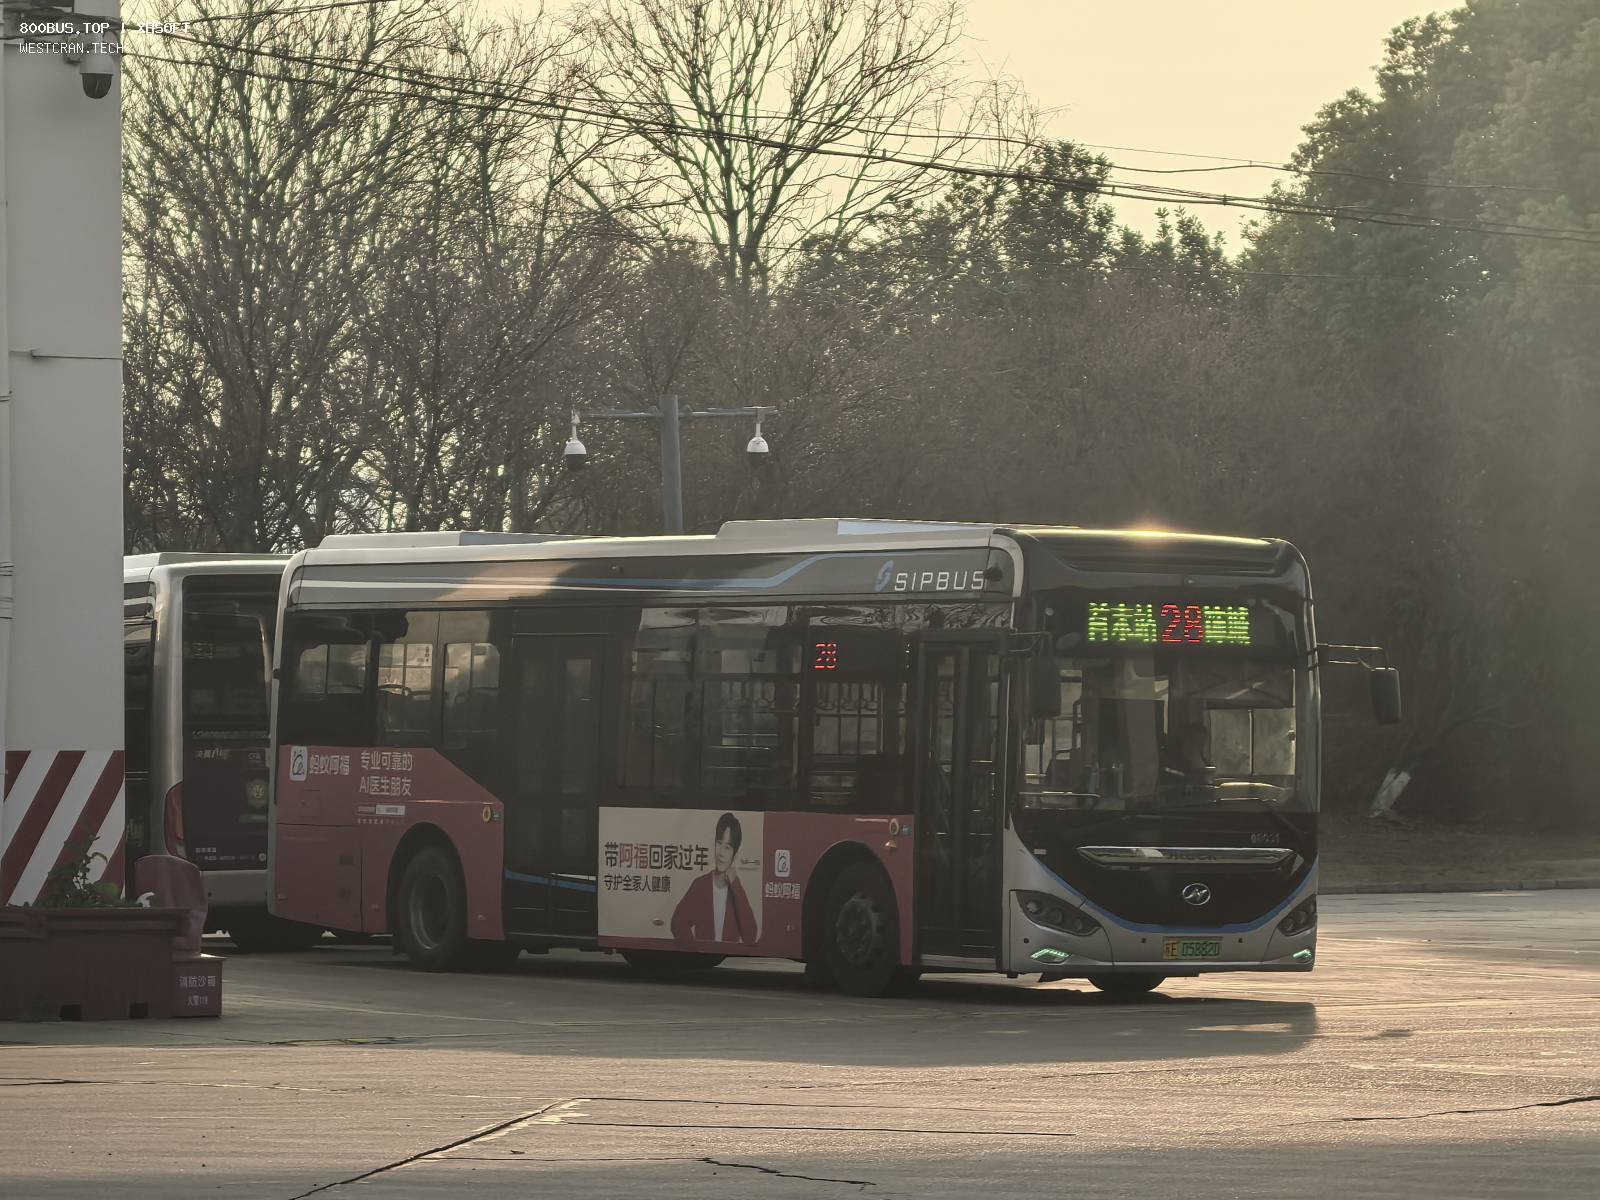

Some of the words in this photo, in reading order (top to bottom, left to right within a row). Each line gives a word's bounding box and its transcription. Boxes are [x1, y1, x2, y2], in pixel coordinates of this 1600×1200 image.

[894, 570, 985, 592] SIPBUS
[1161, 604, 1203, 643] 28
[814, 643, 838, 669] 28
[360, 751, 413, 772] 专业可靠的
[359, 776, 412, 797] AI医生朋友
[604, 841, 709, 871] 带阿福回家过年
